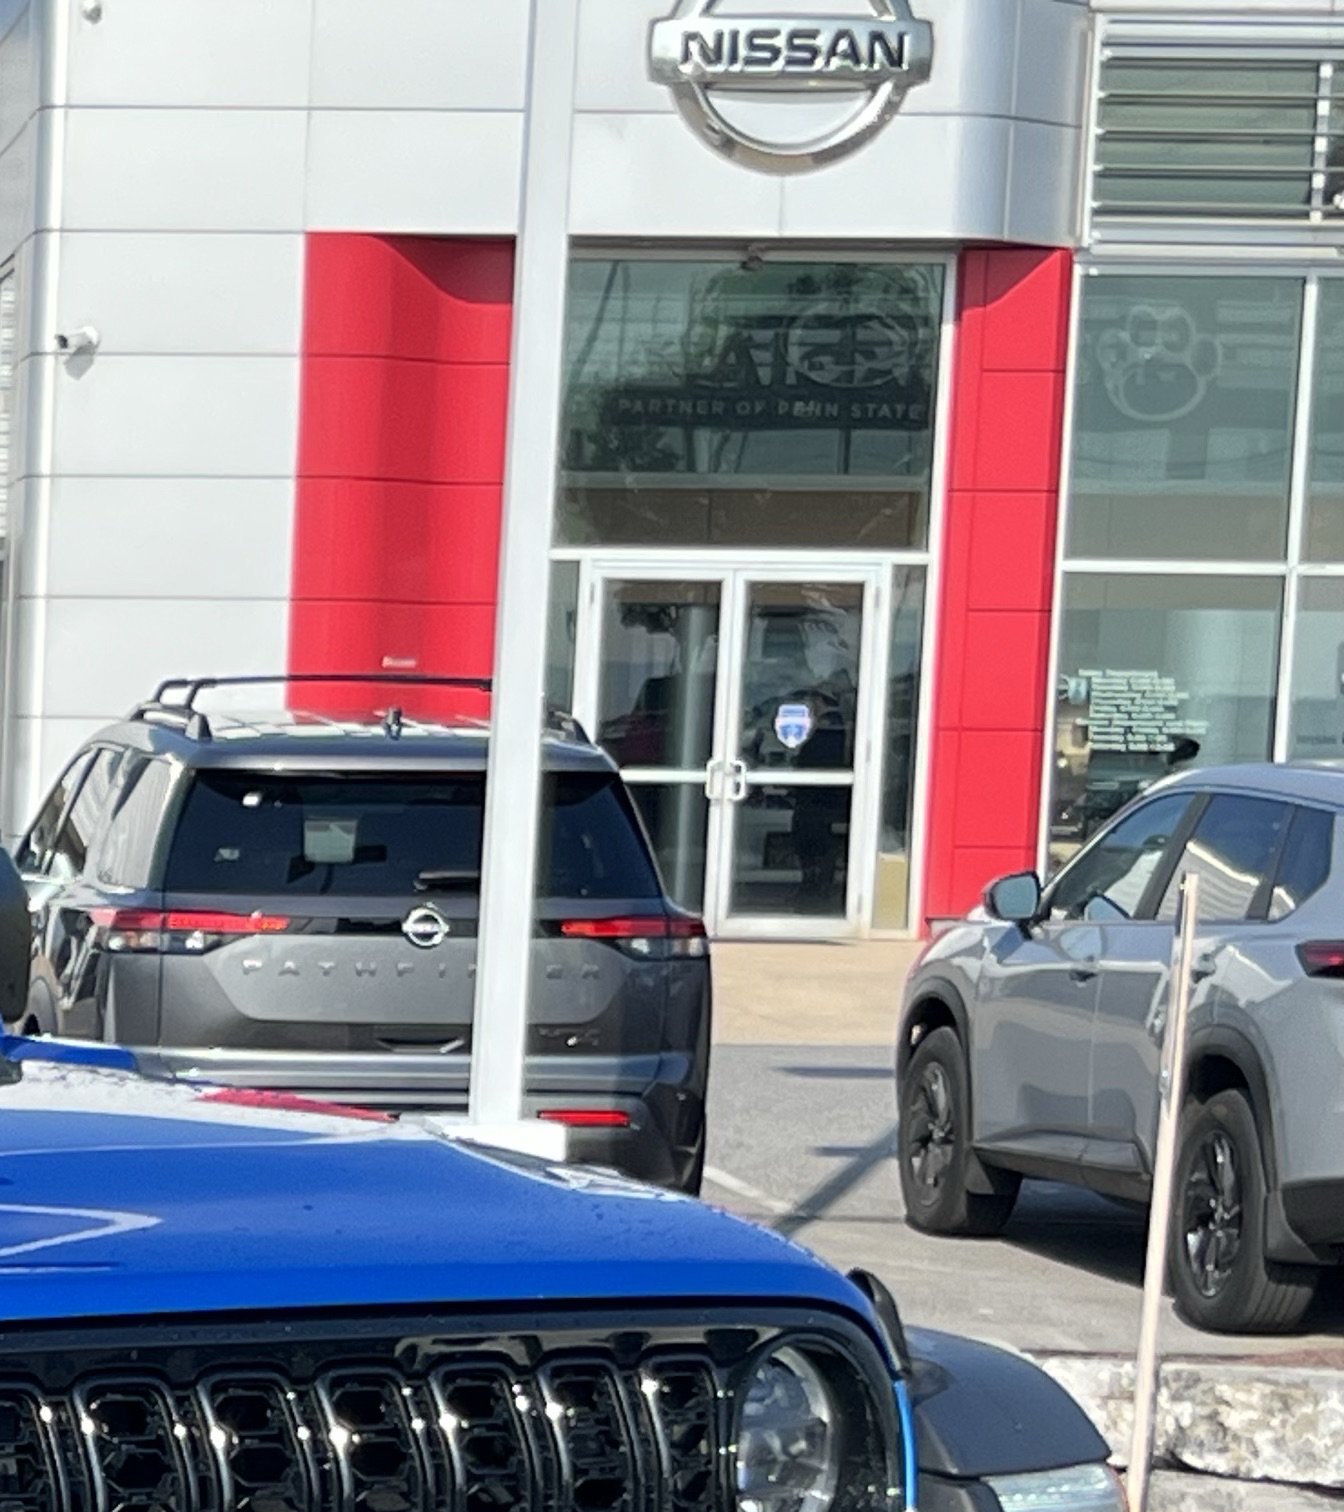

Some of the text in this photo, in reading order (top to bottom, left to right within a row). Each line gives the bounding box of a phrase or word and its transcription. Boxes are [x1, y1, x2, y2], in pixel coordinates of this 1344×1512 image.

[679, 28, 911, 73] NISSAN
[617, 397, 725, 417] PARTNER
[849, 402, 923, 420] STATE
[241, 957, 601, 982] PATHFIER
